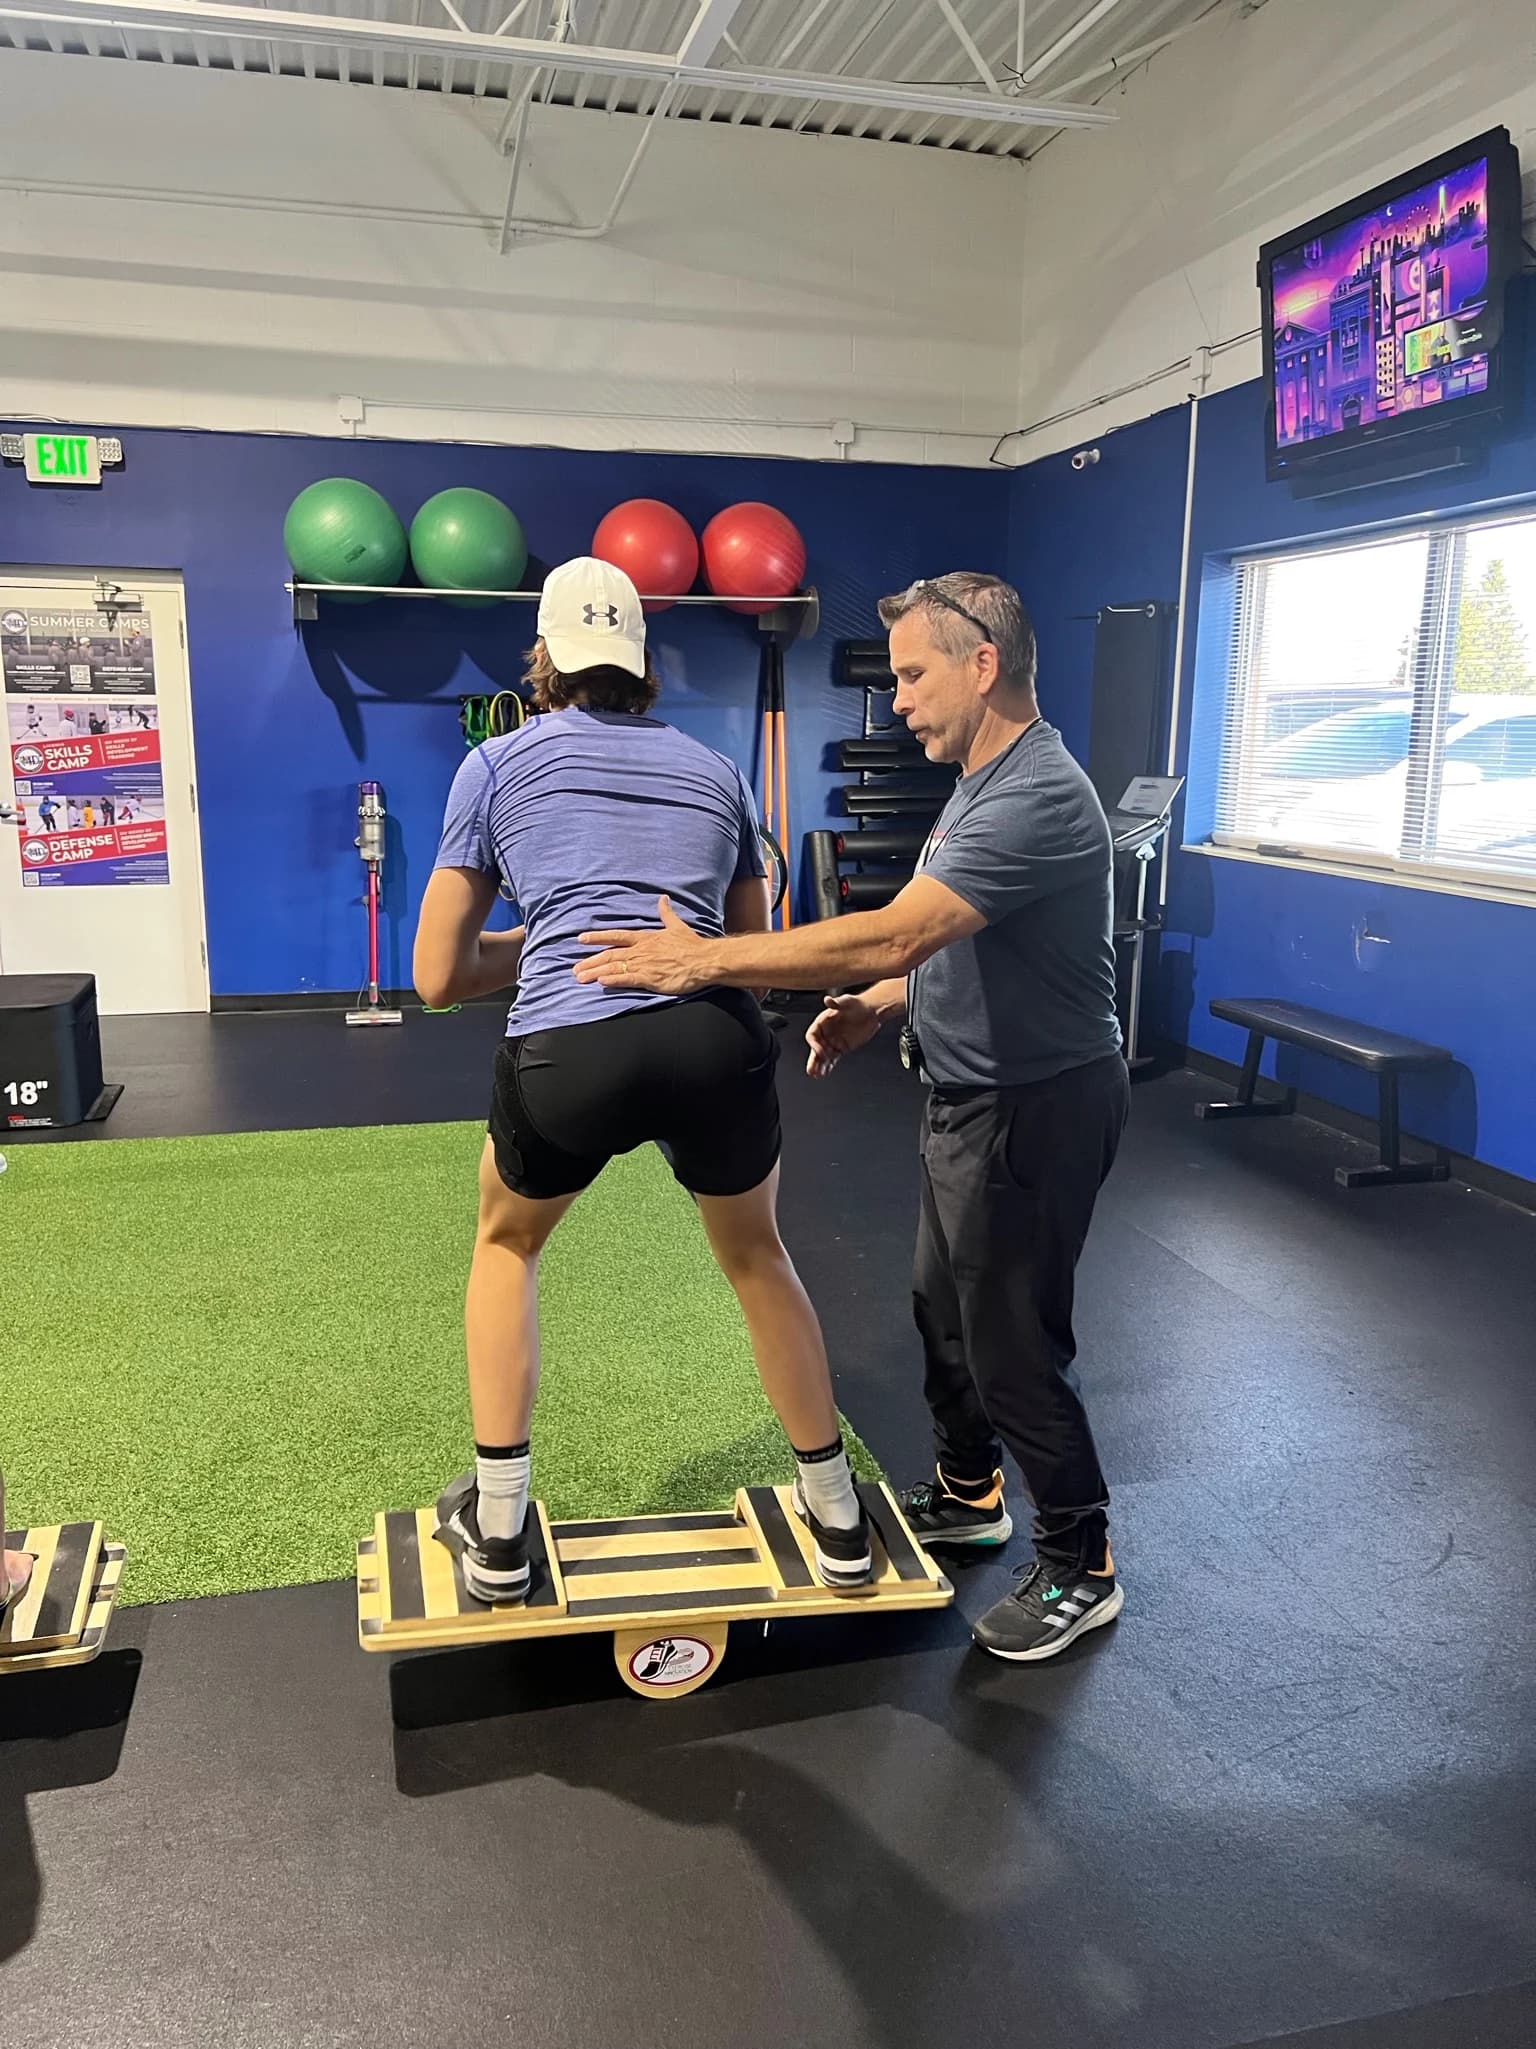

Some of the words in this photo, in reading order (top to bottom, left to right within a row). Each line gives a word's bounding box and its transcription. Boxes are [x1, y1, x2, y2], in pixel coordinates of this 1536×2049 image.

[37, 436, 88, 475] EXIT
[30, 616, 94, 628] SUMMER
[99, 617, 150, 629] CAMPS
[44, 744, 93, 760] SKILLS
[47, 756, 90, 771] CAMP
[50, 834, 114, 851] DEFENSE
[52, 848, 94, 863] CAMP
[4, 1080, 48, 1105] 18"
